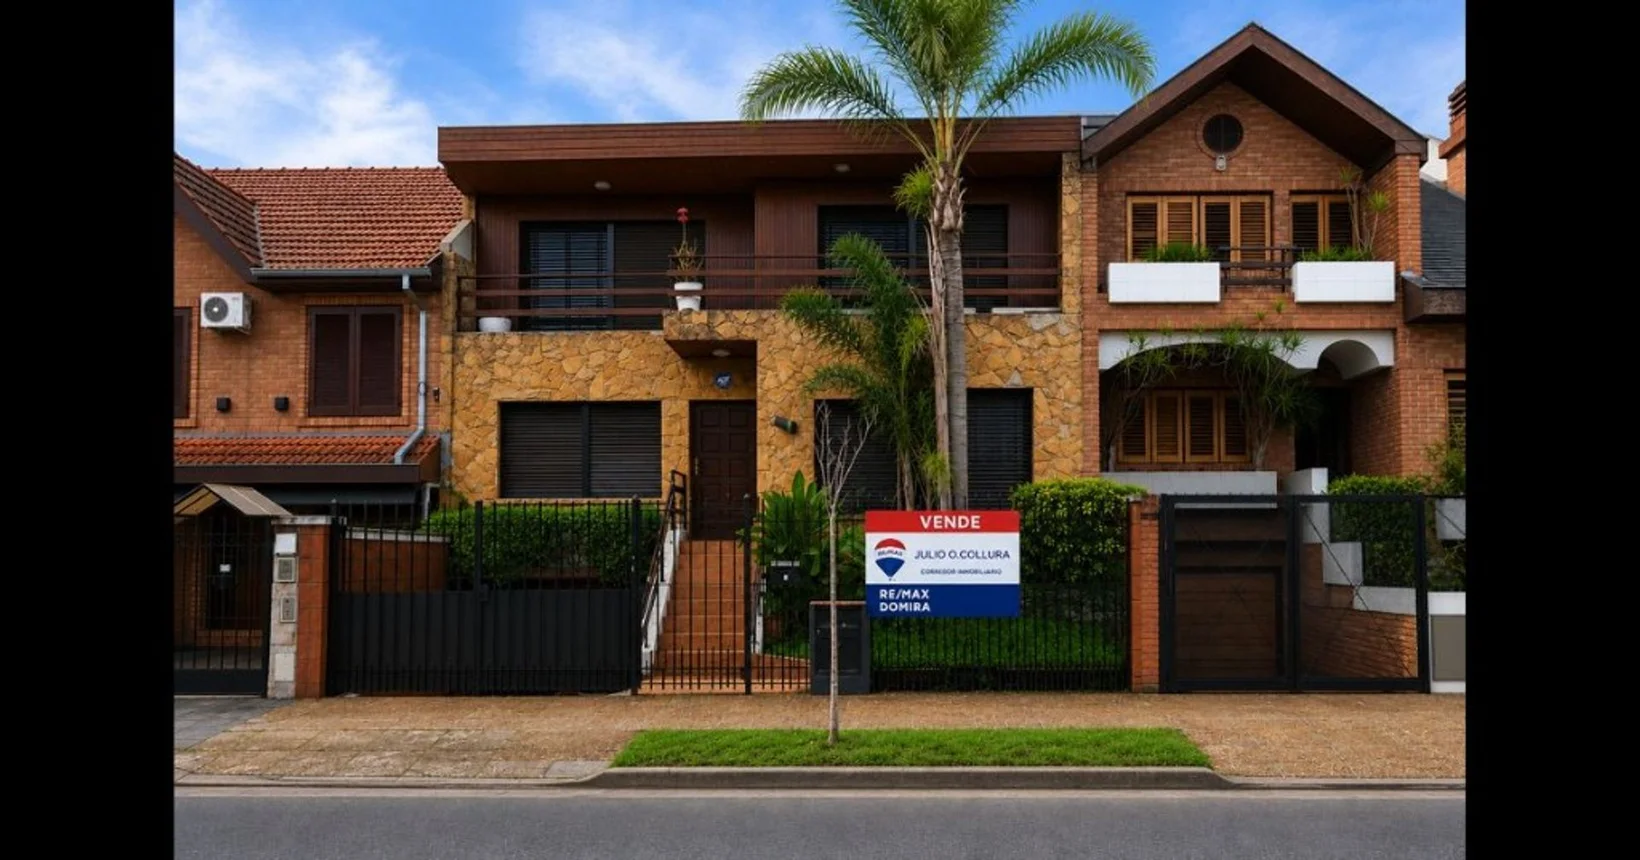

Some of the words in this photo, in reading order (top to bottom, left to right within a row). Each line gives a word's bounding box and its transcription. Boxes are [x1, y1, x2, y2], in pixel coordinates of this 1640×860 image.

[920, 515, 981, 529] VENDE
[914, 550, 946, 560] JULIO
[880, 589, 930, 599] RE/MAX
[880, 602, 931, 612] DOMIRA
